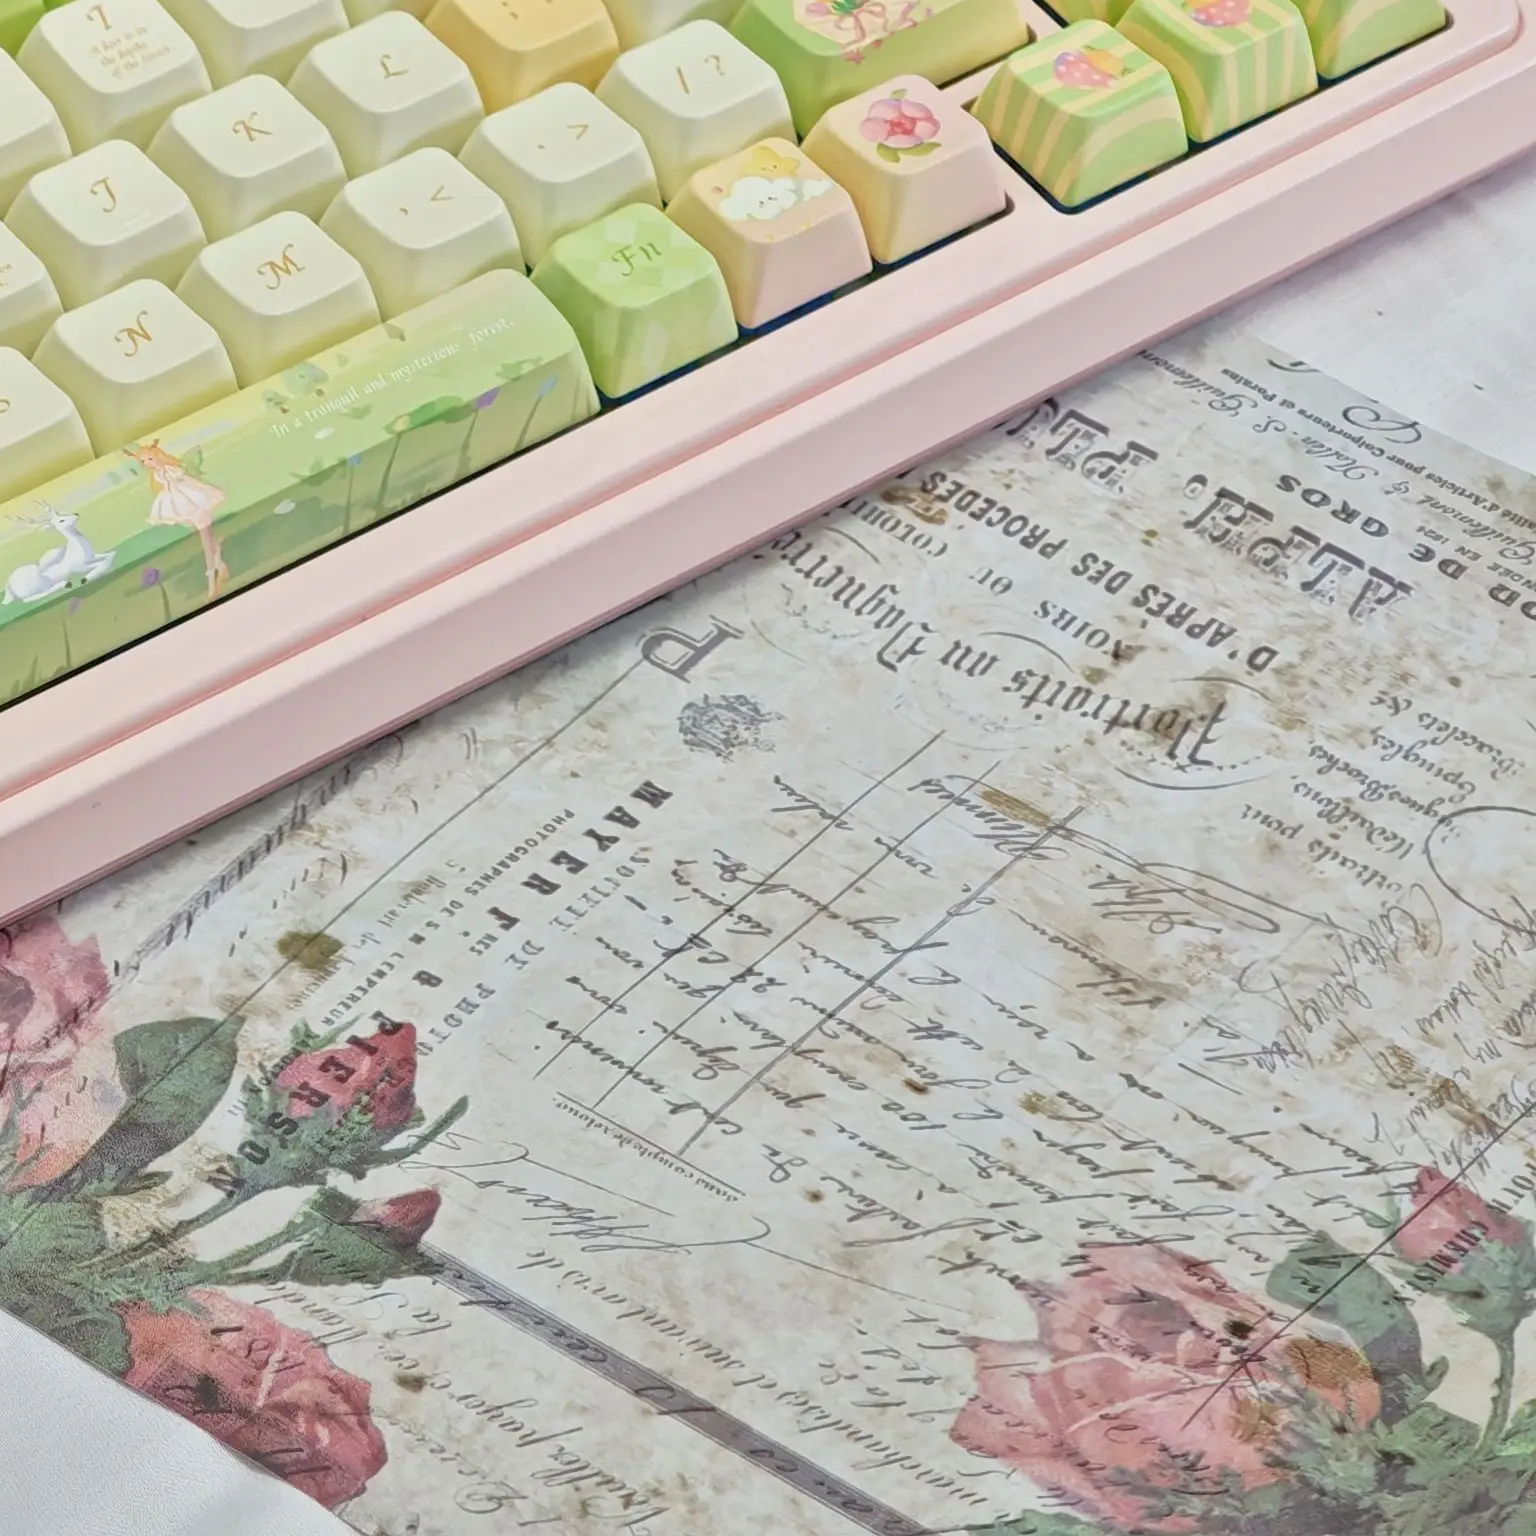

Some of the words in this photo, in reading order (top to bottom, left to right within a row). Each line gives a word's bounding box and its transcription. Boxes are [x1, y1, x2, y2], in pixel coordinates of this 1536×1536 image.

[231, 111, 273, 143] K
[256, 243, 306, 291] M
[610, 242, 663, 278] Fn
[114, 310, 153, 358] N
[1275, 474, 1389, 538] GROS
[1070, 552, 1134, 596] DES
[520, 780, 674, 896] MAYER
